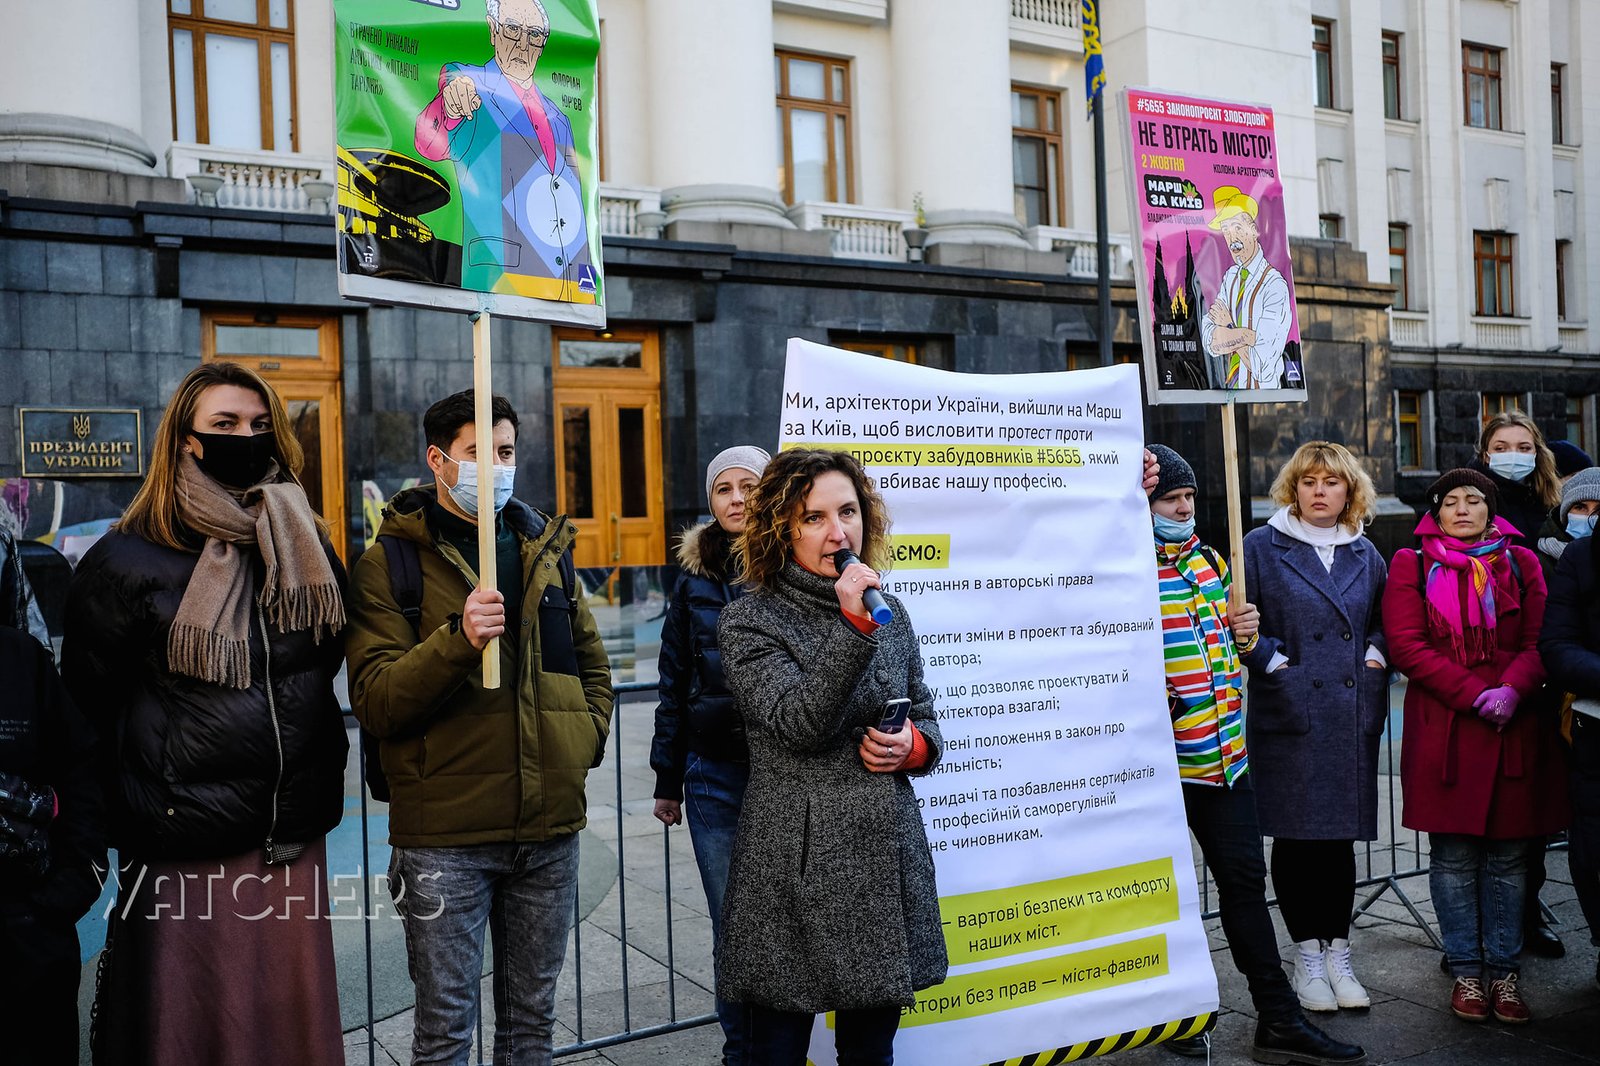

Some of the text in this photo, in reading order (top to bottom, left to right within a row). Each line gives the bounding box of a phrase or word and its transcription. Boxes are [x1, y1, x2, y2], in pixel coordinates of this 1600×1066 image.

[1137, 98, 1164, 113] #5655
[1138, 121, 1272, 160] НЕ ВТРАТЬ МІСТО!
[1142, 154, 1185, 172] 2 ЖОВТНЯ
[1213, 164, 1236, 175] КОЛОНА
[1148, 180, 1182, 194] МАРШ
[1150, 194, 1203, 209] ЗА КИЇВ
[786, 392, 1122, 422] Ми, архітектори України, вийшли на Марш
[784, 418, 1093, 444] за Київ, щоб висловити протест проти
[30, 442, 133, 454] ПРЕЗИДЕНТ
[927, 447, 1033, 467] забудовників
[1037, 448, 1086, 466] #5655,
[1088, 451, 1119, 465] який
[42, 455, 122, 468] УКРАЇНИ
[880, 472, 1067, 492] вбиває нашу професію.
[894, 578, 969, 596] втручання
[974, 578, 982, 590] в
[986, 573, 1054, 591] авторські
[1057, 573, 1094, 587] права
[966, 628, 1004, 642] зміни
[1008, 629, 1016, 640] в
[1020, 626, 1066, 642] проект
[1070, 624, 1084, 636] та
[1088, 618, 1155, 638] збудований
[930, 653, 982, 668] автора;
[946, 686, 967, 698] що
[972, 680, 1034, 697] дозволяє
[1038, 672, 1119, 692] проектувати
[1122, 668, 1130, 682] й
[1008, 696, 1060, 714] взагалі;
[975, 730, 1052, 748] положення
[1055, 729, 1062, 740] в
[1066, 725, 1101, 738] закон
[1104, 722, 1125, 736] про
[930, 788, 978, 808] видачі
[982, 789, 998, 800] та
[1001, 778, 1086, 798] позбавлення
[1090, 765, 1155, 788] сертифікатів
[933, 791, 1117, 831] професійній саморегулівній
[930, 828, 1043, 852] не чиновникам.
[958, 902, 1020, 928] вартові
[1024, 898, 1086, 917] безпеки
[1088, 890, 1104, 903] та
[1106, 876, 1170, 900] комфорту
[969, 923, 1061, 952] наших міст.
[966, 986, 994, 1005] без
[1000, 979, 1037, 1000] прав
[1062, 953, 1160, 985] міста-фавели
